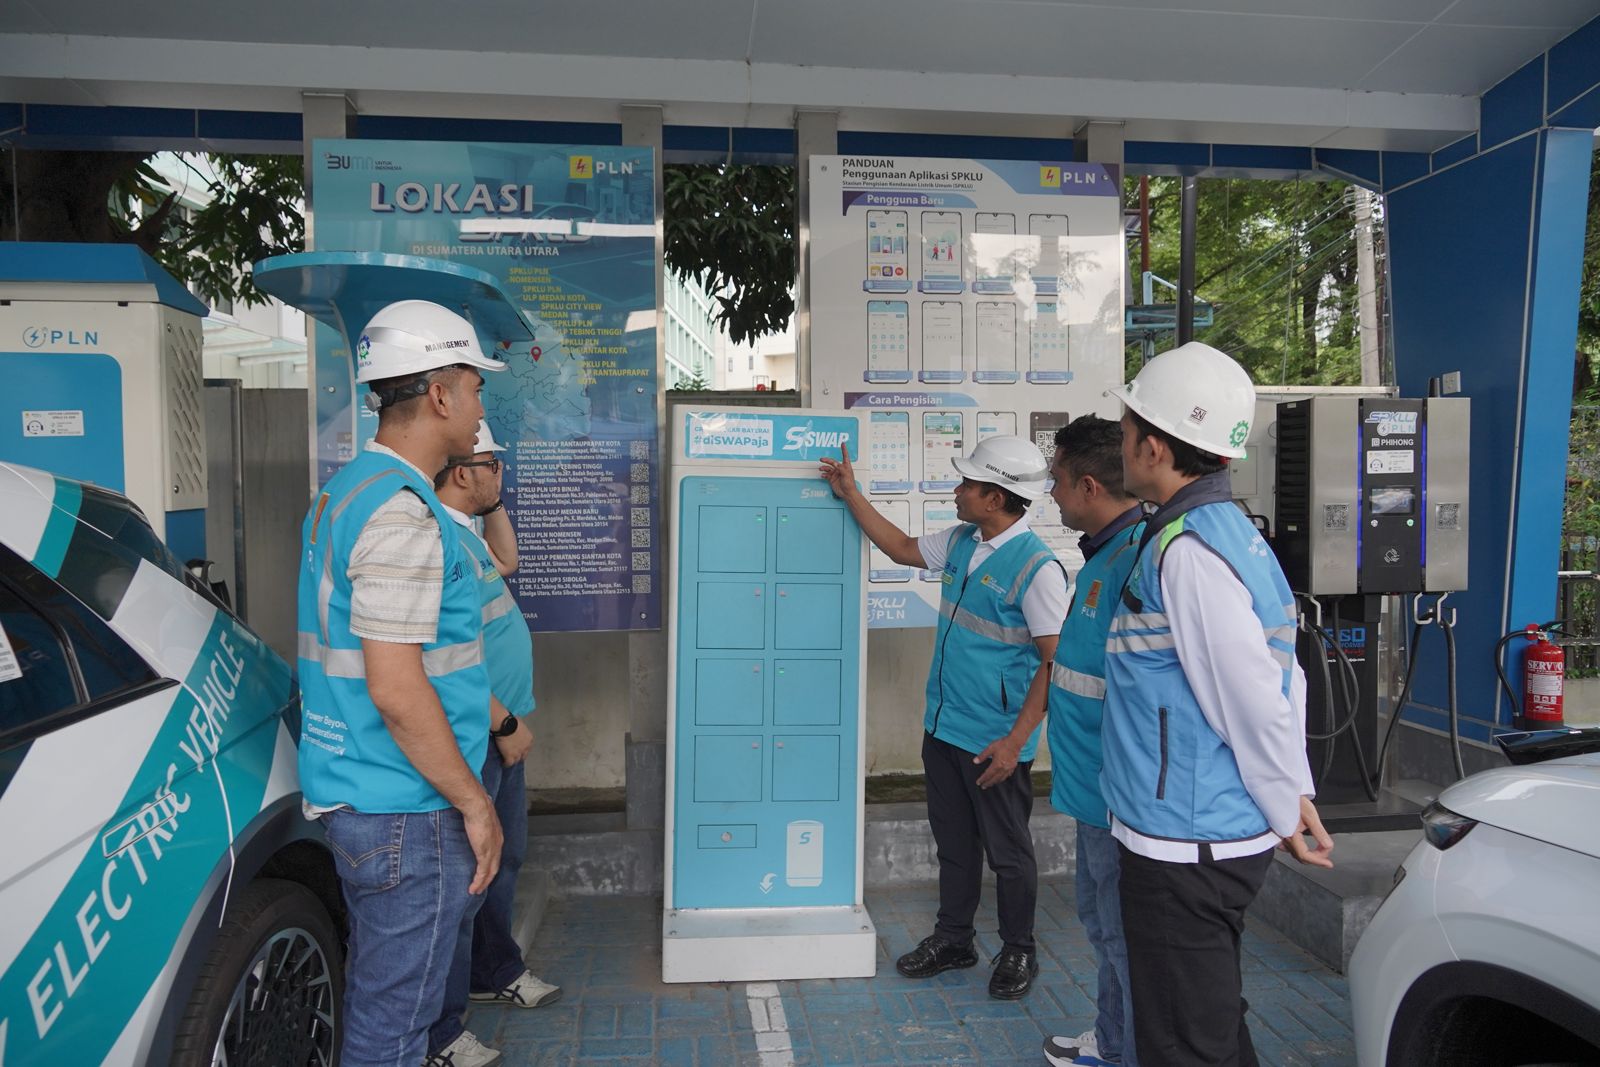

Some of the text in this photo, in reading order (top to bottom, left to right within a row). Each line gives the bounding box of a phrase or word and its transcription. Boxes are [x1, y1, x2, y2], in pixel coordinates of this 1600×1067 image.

[595, 161, 633, 174] PLN
[842, 158, 894, 168] PANDUAN
[842, 169, 983, 181] Penggunaan Aplikasi SPKLU
[1063, 171, 1096, 184] PLN
[370, 182, 534, 213] LOKASI
[867, 194, 944, 206] Pengguna Baru
[412, 245, 560, 256] DI SUMATERA UTARA UTARA
[51, 330, 98, 346] PLN
[425, 339, 470, 352] MANAGEMENT
[868, 395, 942, 407] Cara Pengisian
[1365, 411, 1417, 423] SPKLU
[1392, 424, 1414, 433] PLN
[694, 434, 769, 448] #diSWAPaja
[805, 430, 850, 448] SWAP
[1381, 438, 1414, 446] PHIHONG
[868, 597, 906, 608] PKLU
[877, 610, 905, 620] PLN
[1080, 606, 1097, 619] PLN
[178, 630, 245, 773] VEHICLE
[26, 763, 191, 1039] ELECTRIC
